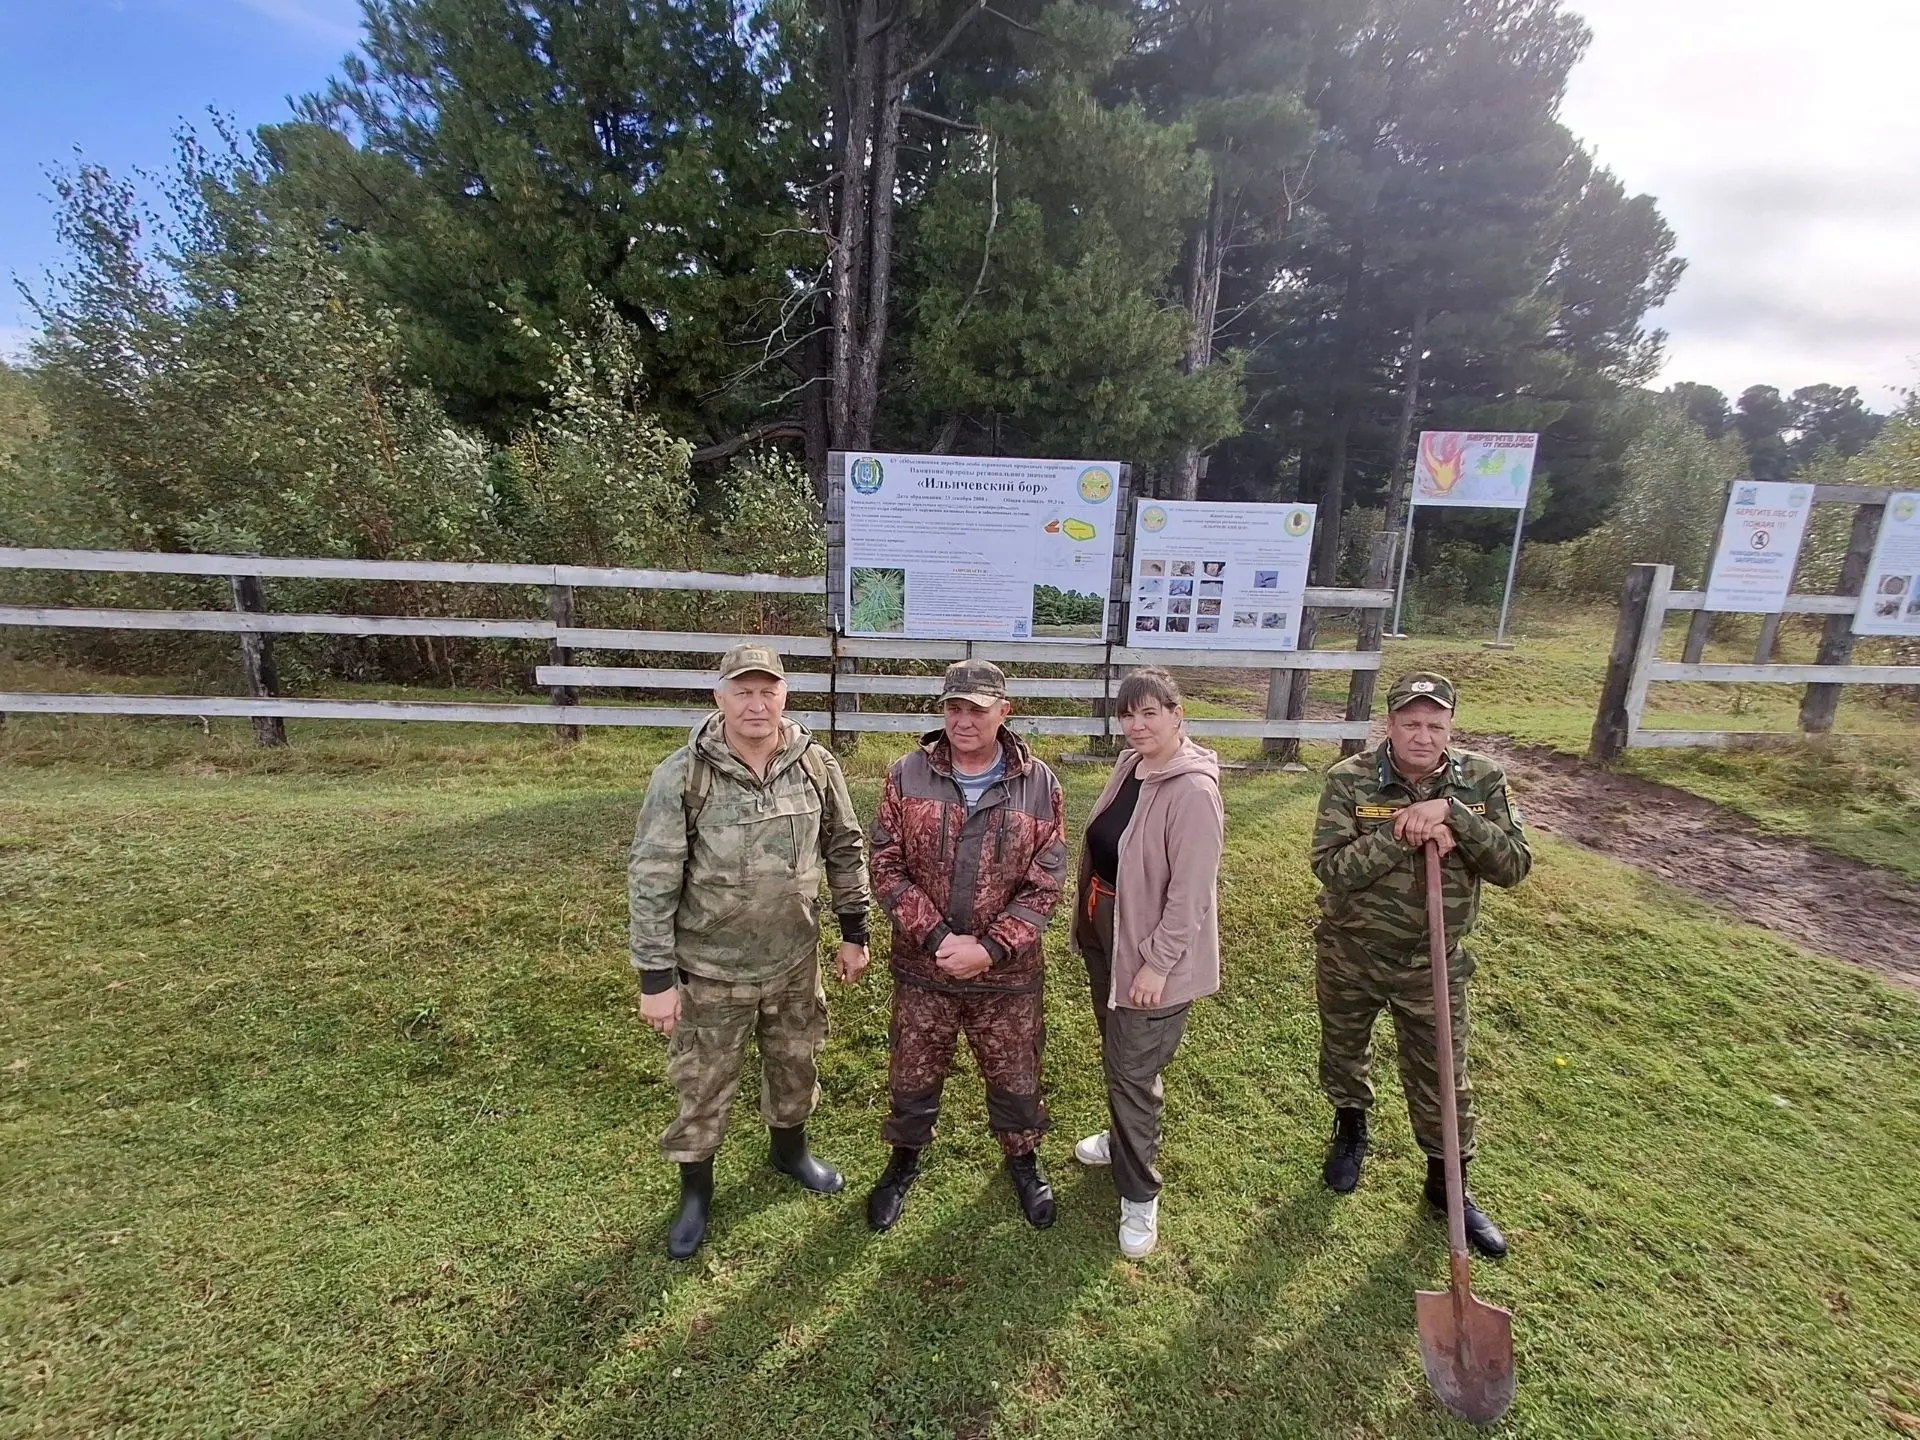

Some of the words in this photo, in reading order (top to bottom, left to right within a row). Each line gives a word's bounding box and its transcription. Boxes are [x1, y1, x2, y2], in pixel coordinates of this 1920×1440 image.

[1466, 434, 1514, 442] БЕРЕГИТЕ
[917, 477, 1015, 492] «Ильичевский
[1018, 481, 1048, 494] бор»
[1735, 508, 1771, 516] БЕРЕГИТЕ
[1773, 509, 1788, 517] ЛЕС
